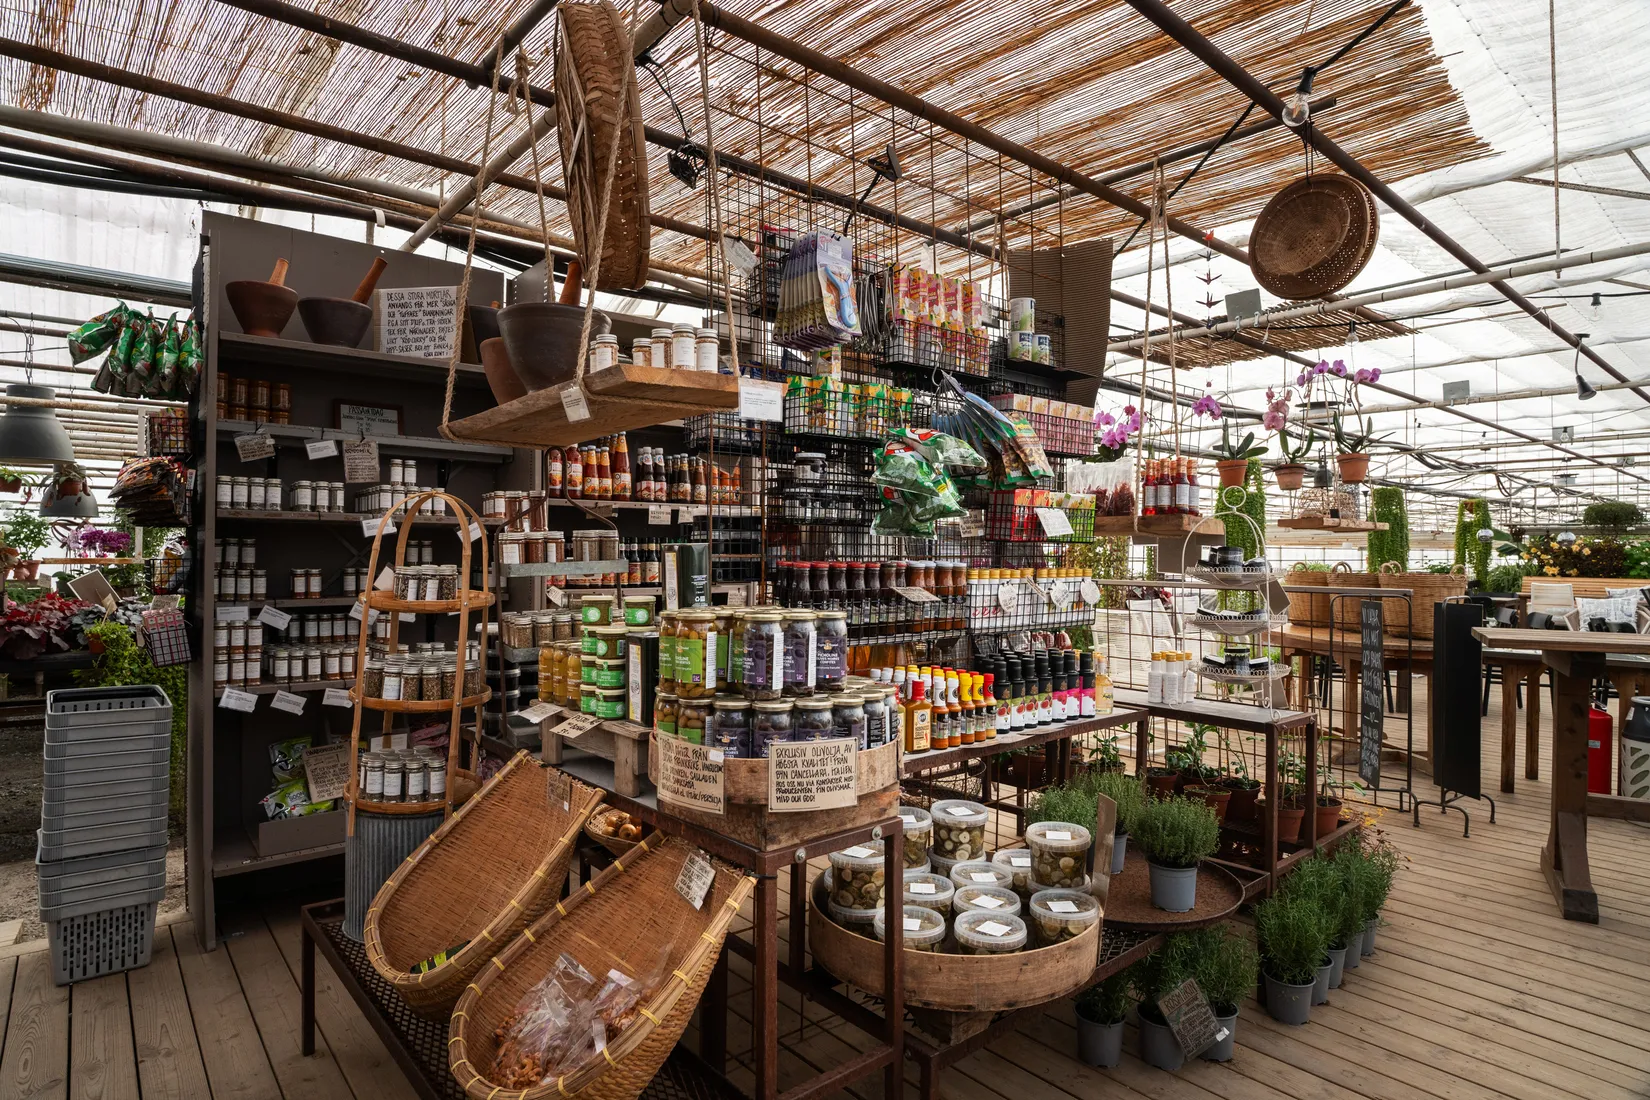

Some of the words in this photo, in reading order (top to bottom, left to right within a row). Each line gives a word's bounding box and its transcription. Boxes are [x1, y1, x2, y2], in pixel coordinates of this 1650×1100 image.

[387, 293, 404, 301] DESSA
[408, 292, 425, 300] STORA
[426, 300, 439, 308] MER
[692, 748, 708, 761] FRÅN
[776, 746, 807, 758] EXKLUSIV
[812, 745, 840, 757] OLIVOLJA
[844, 744, 852, 754] AV
[776, 758, 798, 769] HÖGSTA
[834, 754, 848, 765] FRÅN
[776, 770, 788, 779] BYN
[1164, 983, 1198, 1012] ROSMARIN
